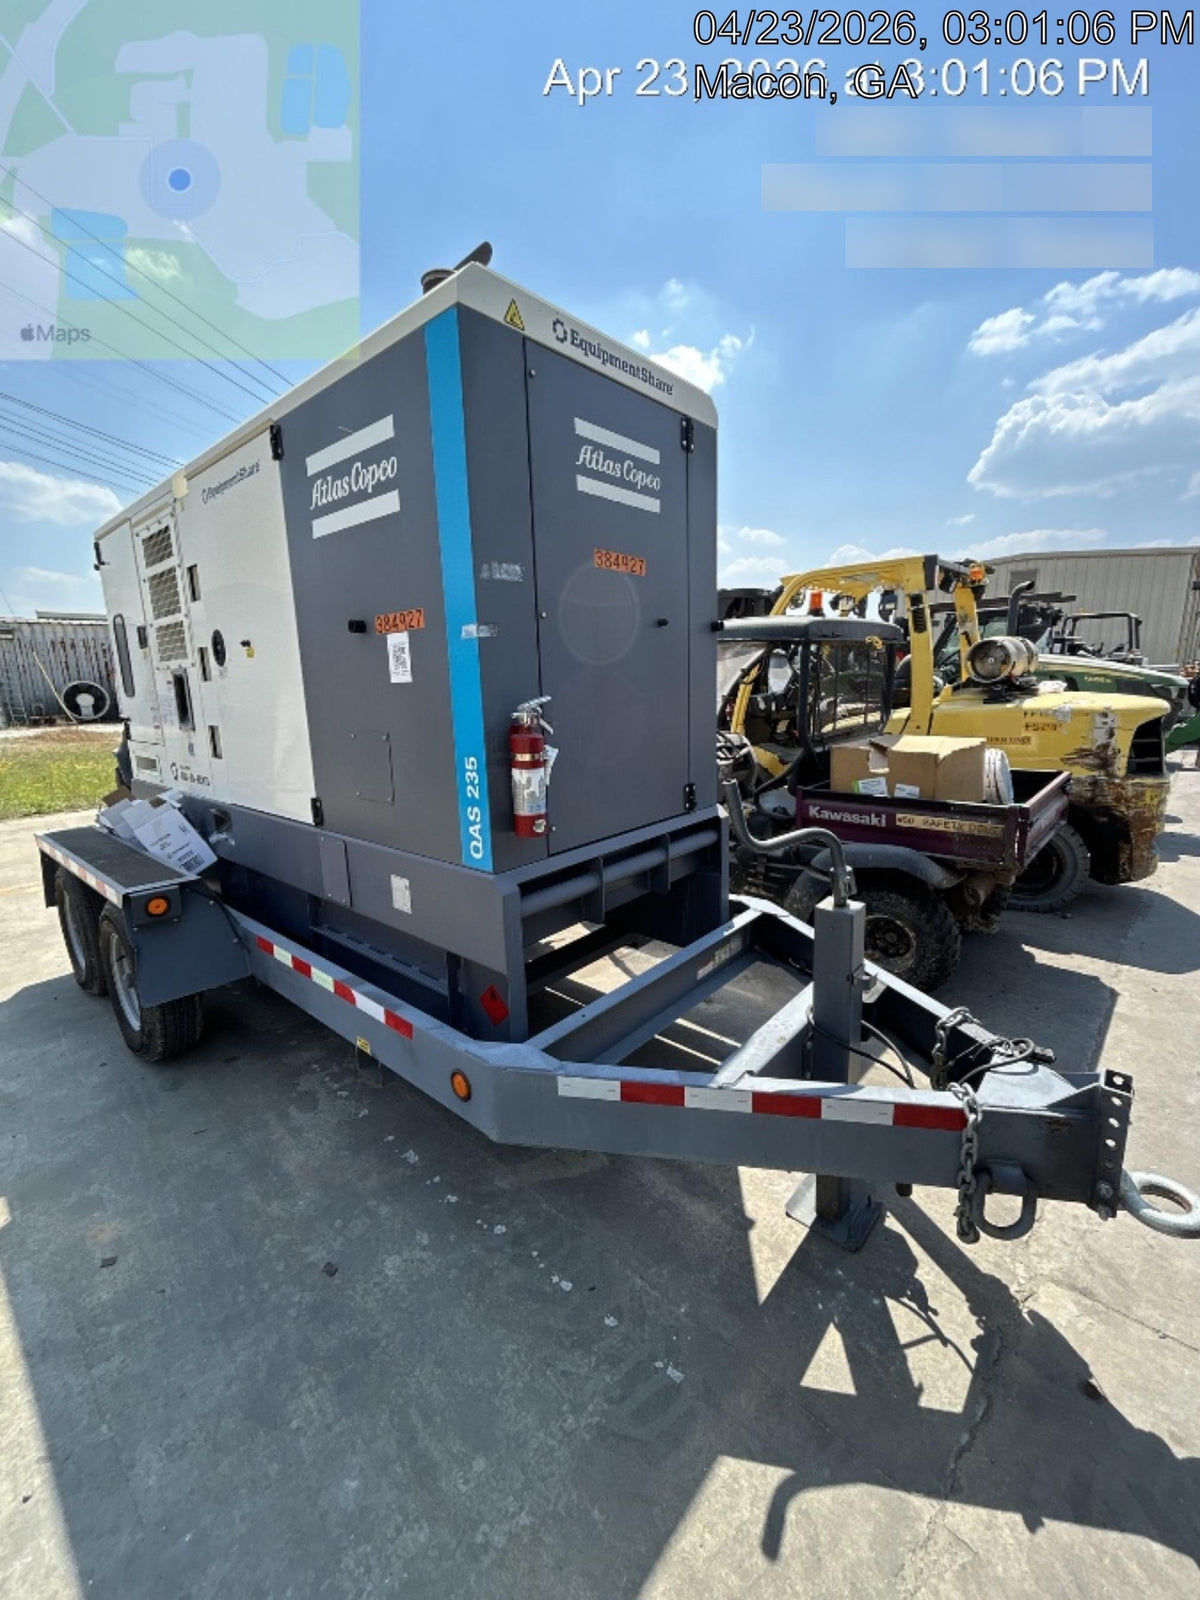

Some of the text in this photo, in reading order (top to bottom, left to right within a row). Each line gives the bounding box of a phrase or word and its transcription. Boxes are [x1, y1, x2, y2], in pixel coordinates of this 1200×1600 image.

[570, 328, 674, 396] EquipmentShare
[309, 456, 398, 511] Atlas Copco
[576, 445, 661, 491] Atlas Copco
[465, 757, 485, 859] QAS 235
[808, 805, 887, 827] Kawasaki
